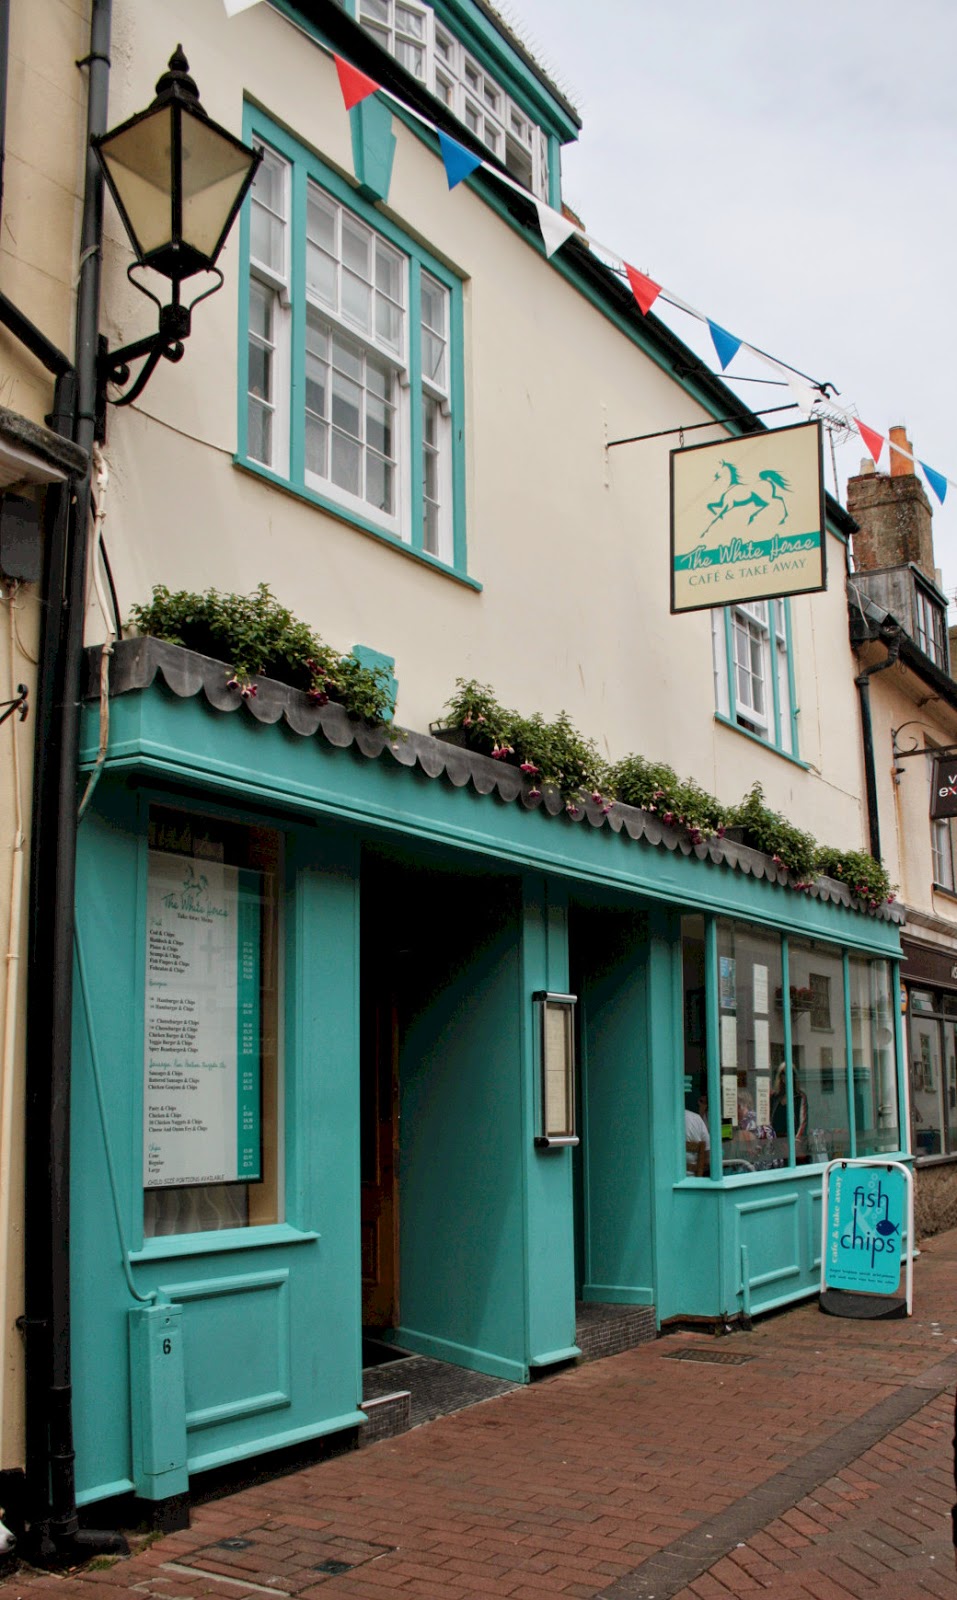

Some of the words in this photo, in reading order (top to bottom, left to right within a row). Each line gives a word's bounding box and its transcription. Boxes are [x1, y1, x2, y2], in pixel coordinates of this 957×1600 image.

[680, 545, 713, 570] The
[719, 537, 763, 564] White
[769, 534, 815, 562] Horse
[688, 570, 719, 586] CAFÉ
[725, 569, 734, 580] &
[740, 564, 768, 578] TAKE
[773, 558, 806, 573] AWAY
[161, 893, 178, 909] The
[181, 894, 205, 913] White
[853, 1180, 889, 1210] fish
[840, 1208, 895, 1269] chips
[163, 1338, 171, 1355] 6
